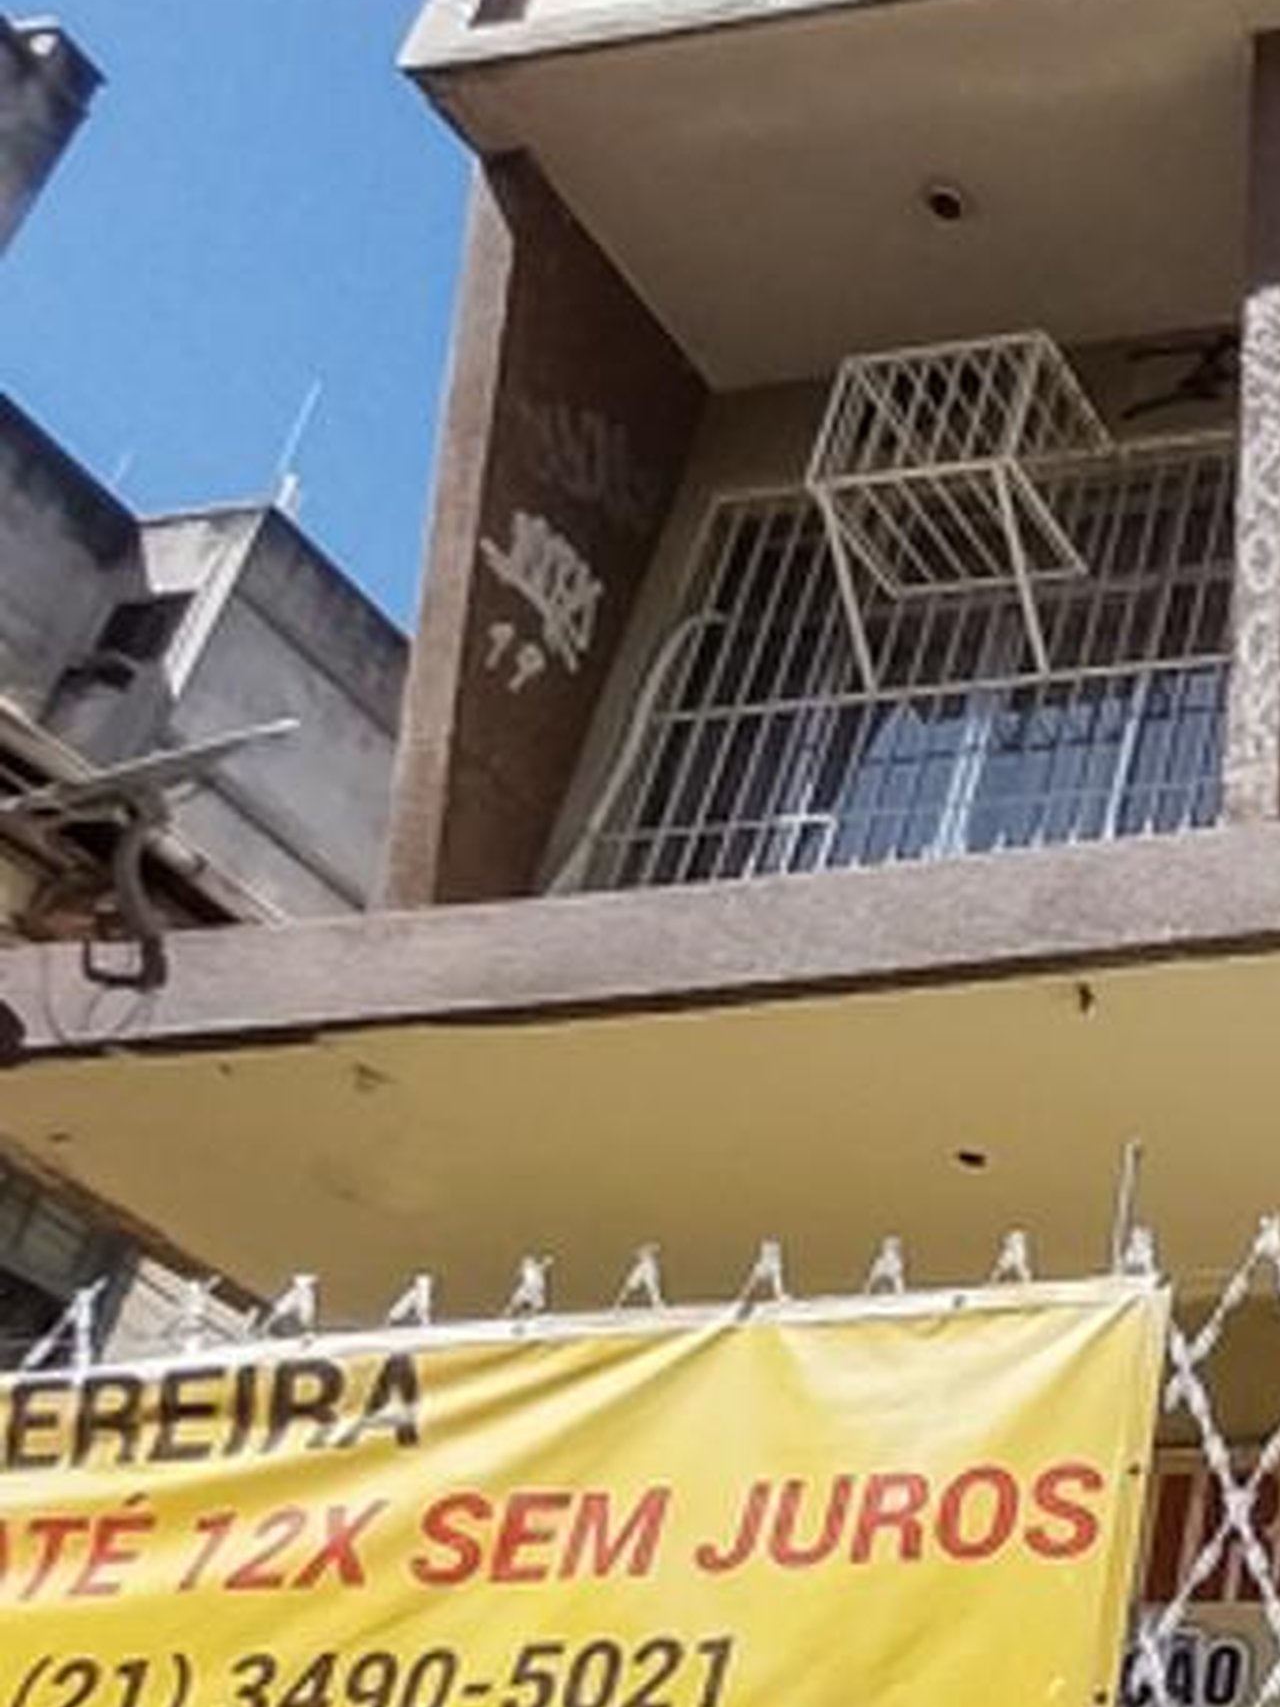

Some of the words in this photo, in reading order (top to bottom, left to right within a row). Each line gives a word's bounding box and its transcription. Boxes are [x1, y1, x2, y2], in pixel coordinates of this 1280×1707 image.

[0, 1493, 156, 1602] TÉ
[177, 1498, 389, 1592] 12X
[410, 1487, 671, 1584] SEM
[695, 1463, 1106, 1574] JUROS
